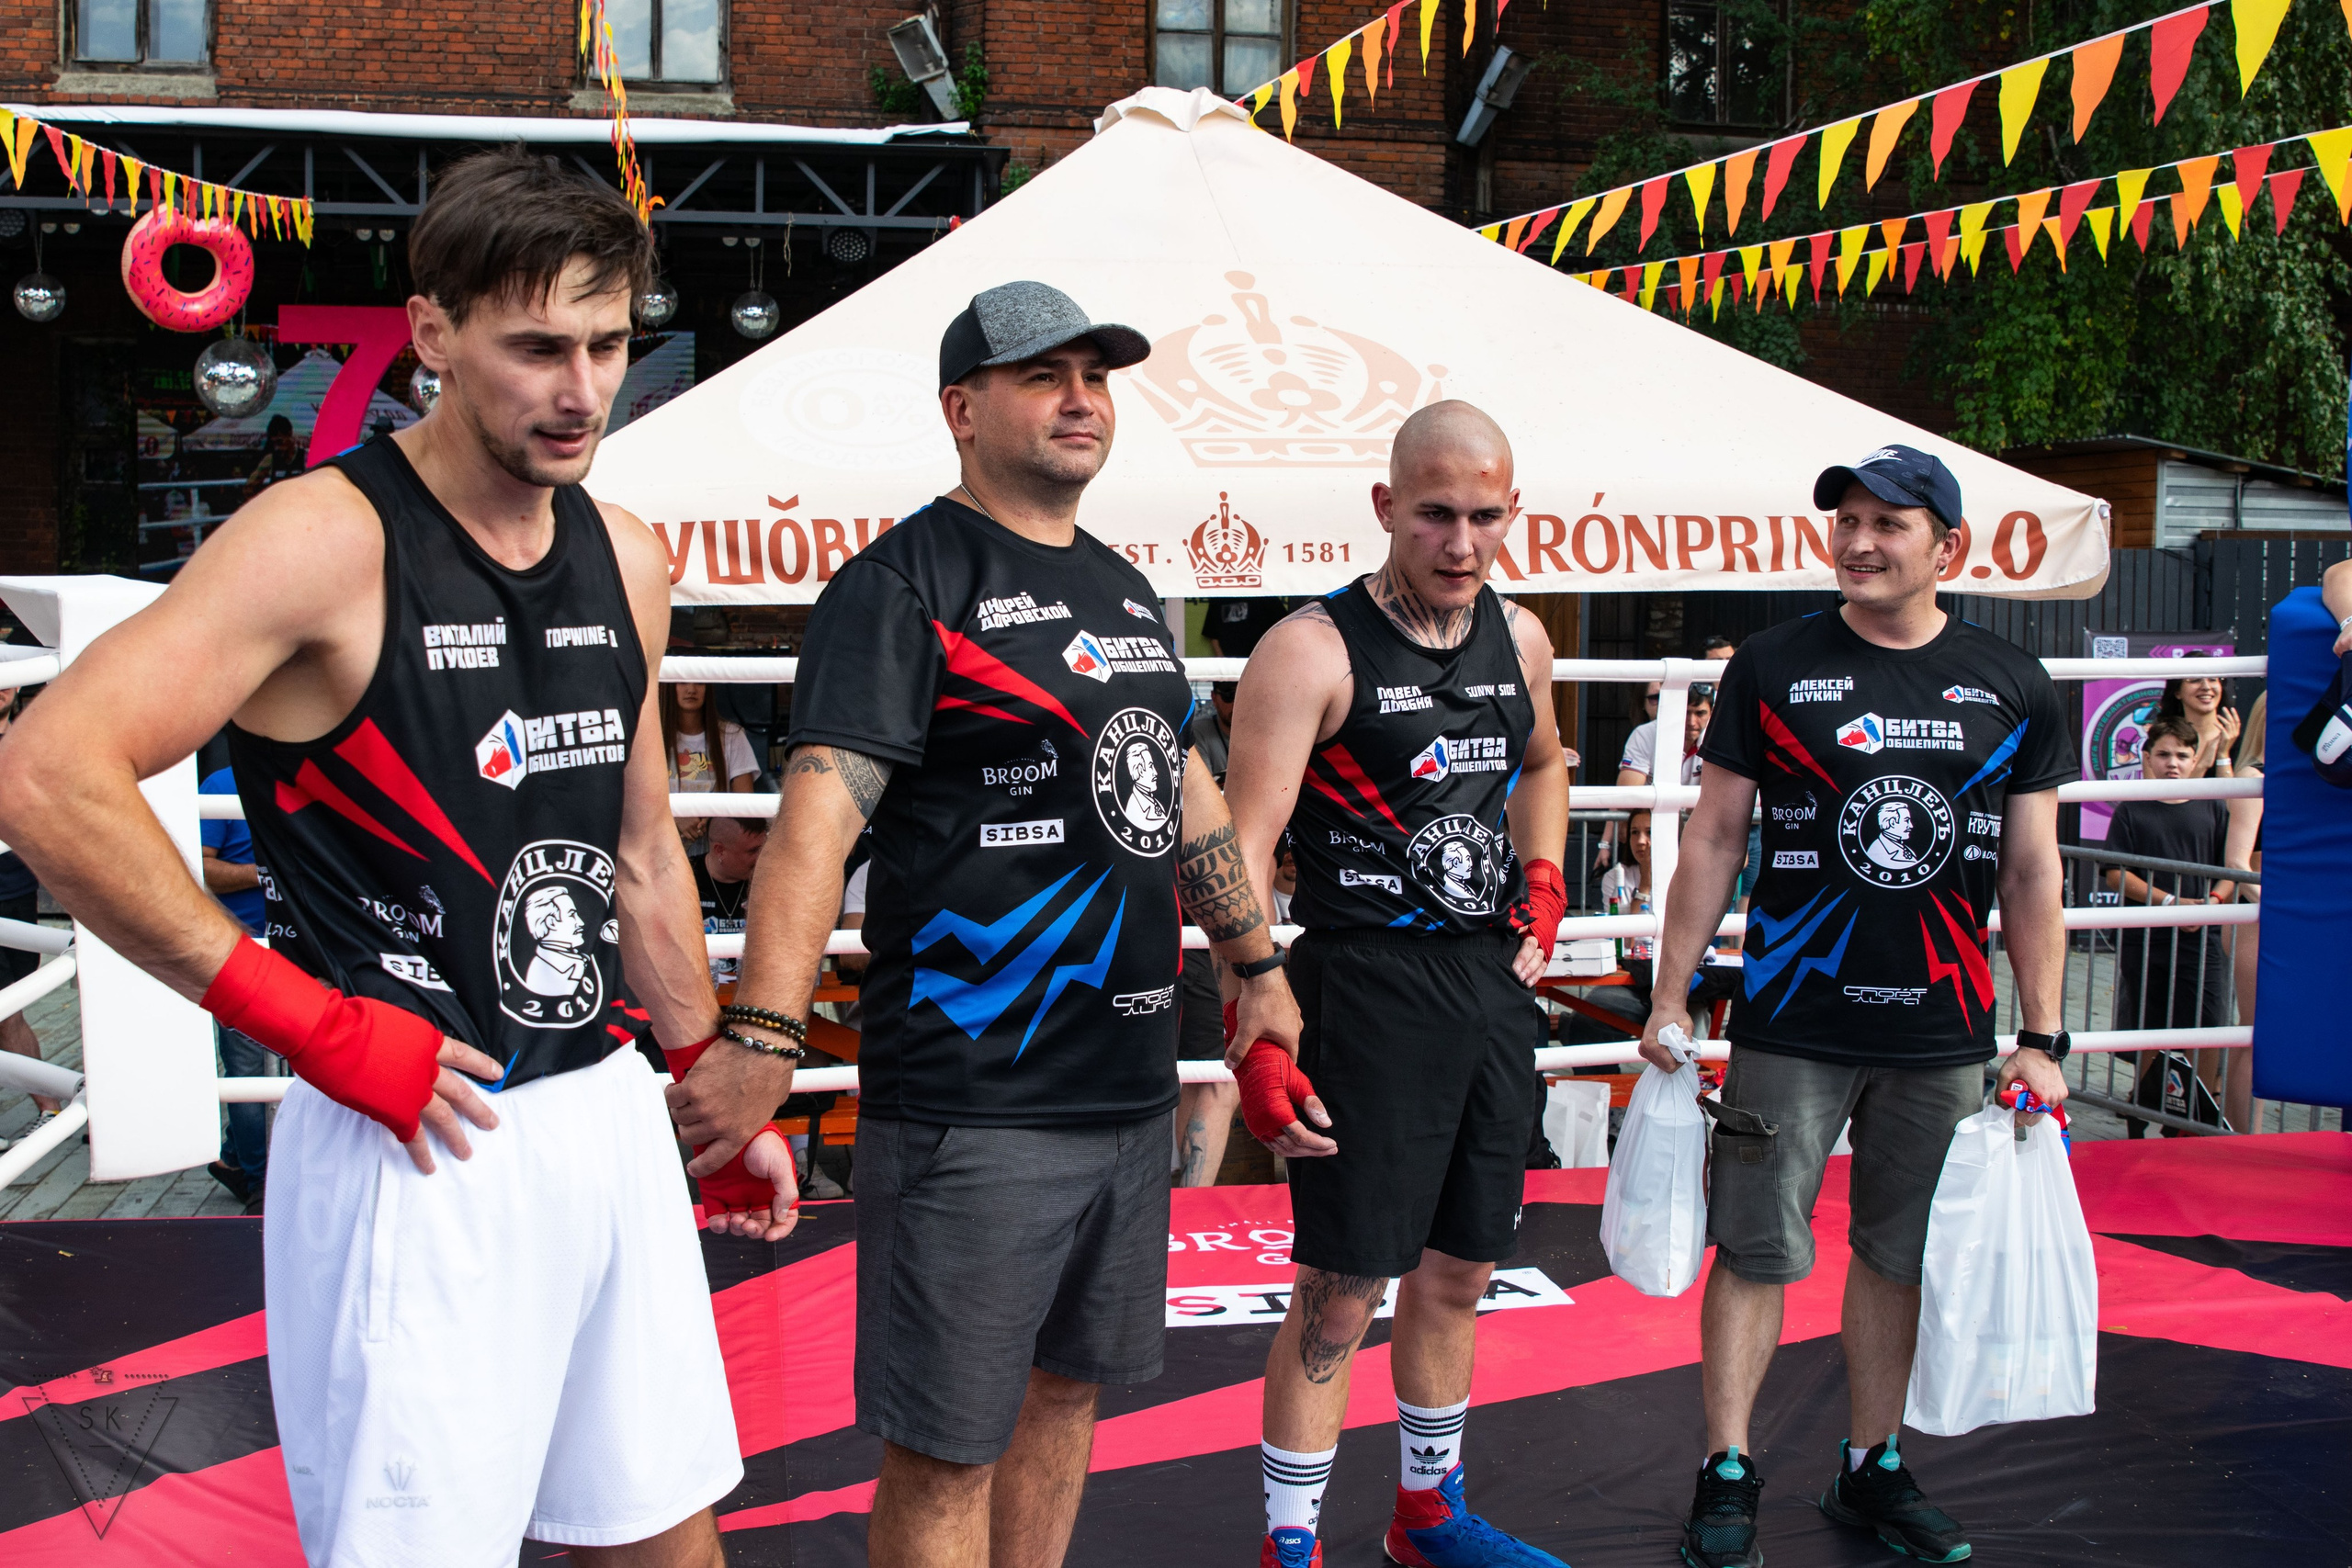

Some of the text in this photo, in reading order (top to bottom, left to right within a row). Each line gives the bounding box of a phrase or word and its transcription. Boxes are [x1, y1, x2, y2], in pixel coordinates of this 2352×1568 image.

[1486, 492, 1837, 581] KRÓNPRIN
[1283, 542, 1351, 563] 1581
[977, 592, 1037, 618] АНДРЕЙ
[423, 616, 507, 648] ВИТАЛИЙ
[1098, 637, 1170, 659] БИТВА
[1110, 660, 1177, 673] ОБЩЕПИТОВ
[1376, 686, 1423, 701] ПАВЕЛ
[1498, 683, 1517, 696] SIDE
[1789, 676, 1854, 692] АЛЕКСЕЙ
[1790, 691, 1843, 705] ЩУКИН
[1964, 688, 2000, 706] БИТВА
[523, 708, 626, 752] БИТВА
[1885, 718, 1964, 739] БИТВА
[1097, 713, 1181, 794] КАНЦЛЕРЪ
[1448, 737, 1507, 761] БИТВА
[1885, 738, 1964, 751] ОБЩЕПИТОВ
[527, 744, 626, 774] ОБЩЕПИТОВ
[981, 759, 1058, 786] BROOM
[1009, 785, 1033, 796] GIN
[1771, 807, 1816, 821] BROOM
[1842, 779, 1951, 840] КАНЦЛЕРЪ
[986, 824, 1060, 842] SIBSA
[1120, 820, 1174, 849] 2010
[1775, 854, 1816, 865] SIBSA
[1344, 871, 1399, 891] SISA
[1859, 861, 1931, 883] 2010
[498, 849, 616, 962] КАНЦЛЕ
[389, 961, 446, 983] SIB
[1168, 1229, 1295, 1252] BRO
[1409, 1465, 1448, 1476] adidas
[366, 1495, 429, 1509] NOCTA
